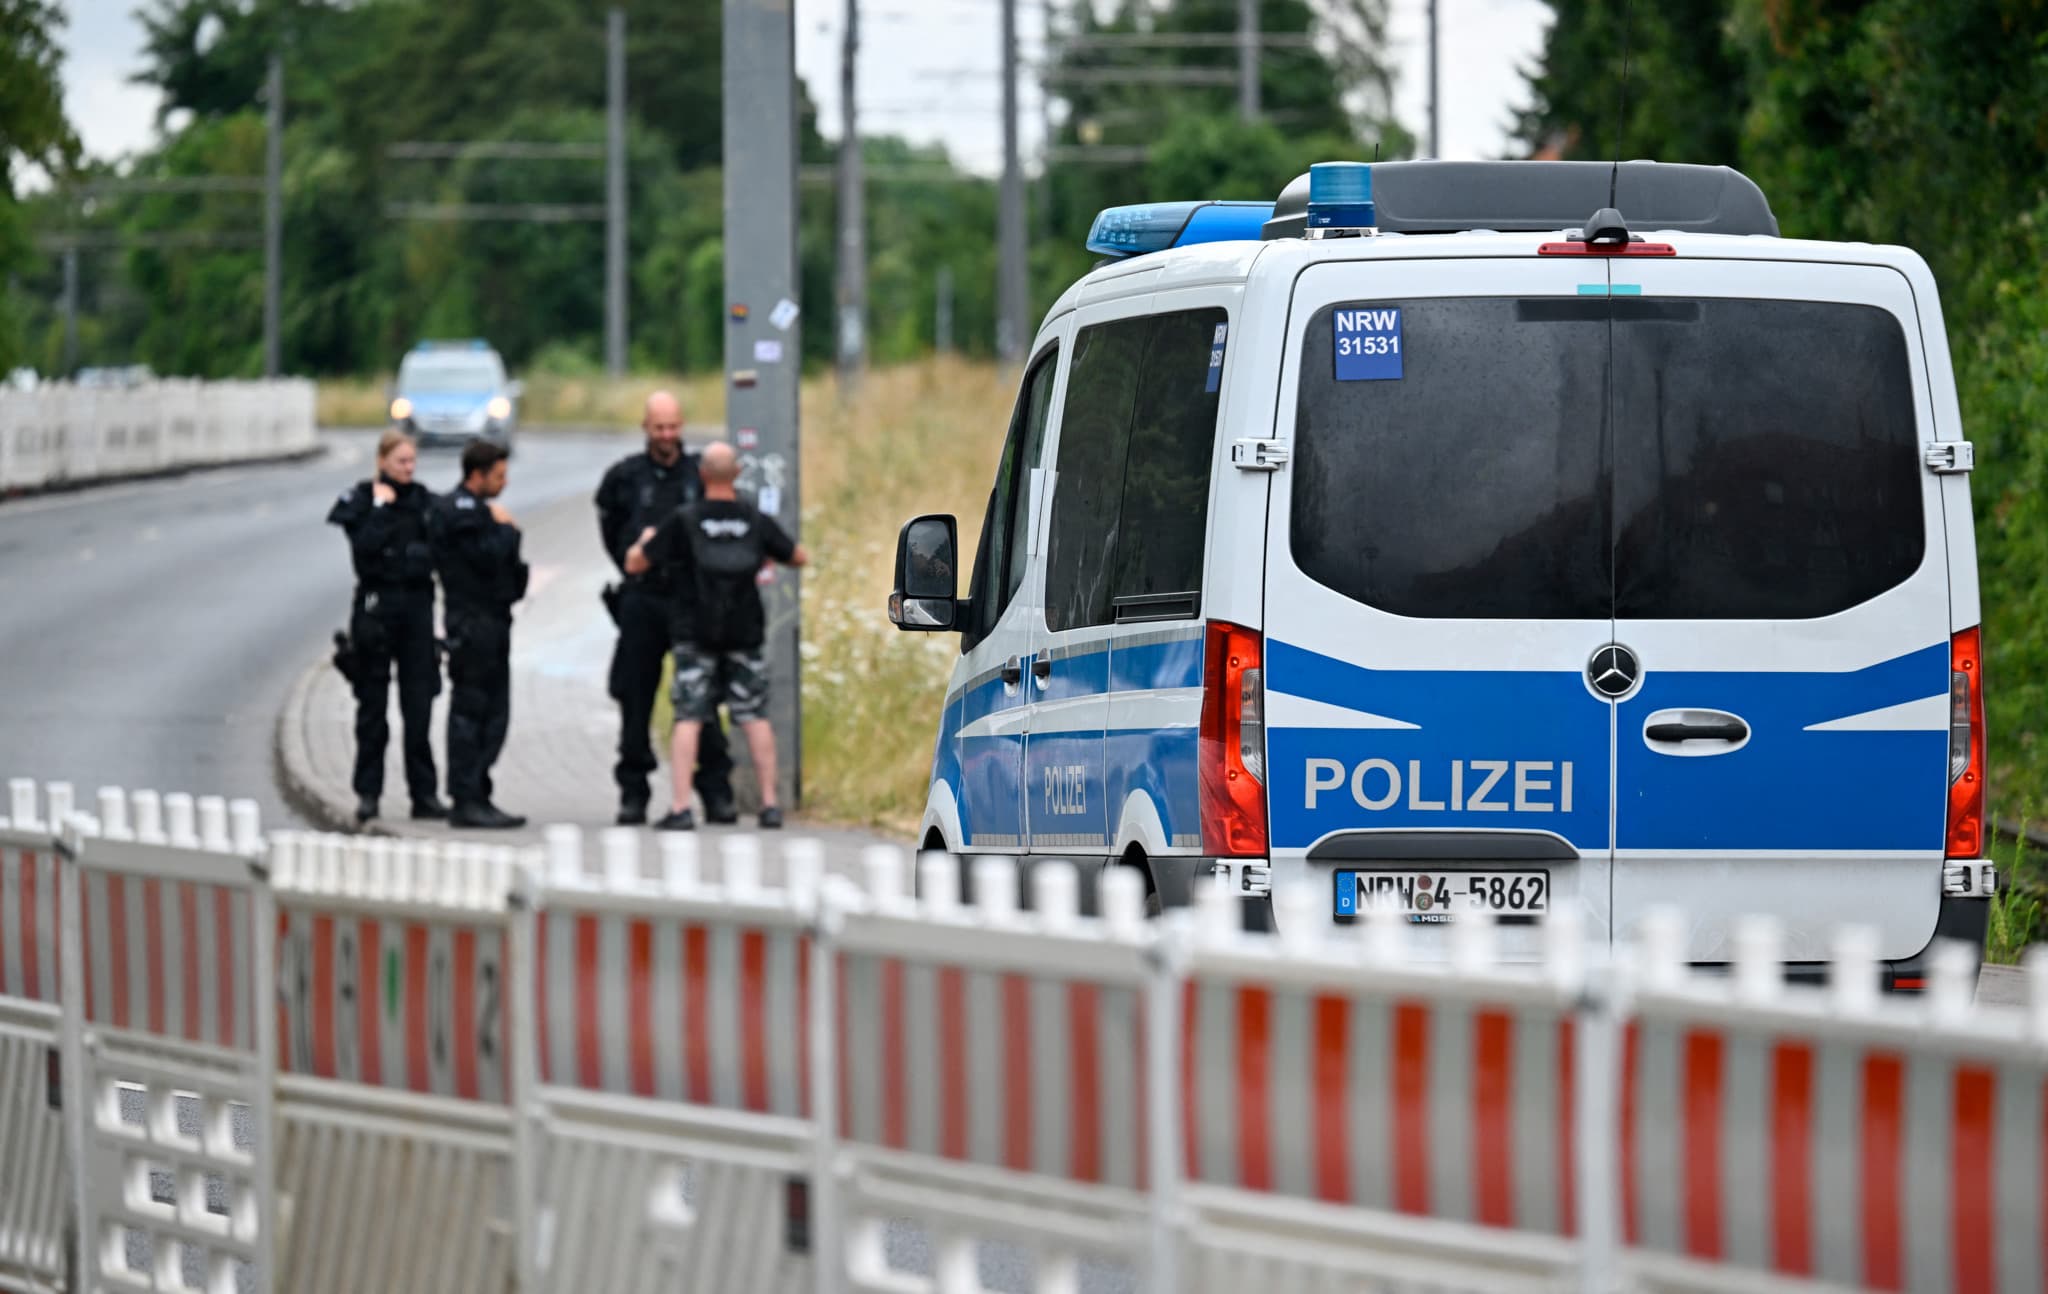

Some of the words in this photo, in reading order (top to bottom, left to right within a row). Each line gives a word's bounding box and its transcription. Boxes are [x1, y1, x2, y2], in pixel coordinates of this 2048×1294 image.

[1337, 310, 1397, 332] NRW
[1339, 336, 1399, 355] 31531
[1045, 765, 1087, 815] POLIZEI
[1305, 758, 1573, 812] POLIZEI
[1342, 897, 1350, 907] D
[1434, 876, 1544, 910] 4-5862
